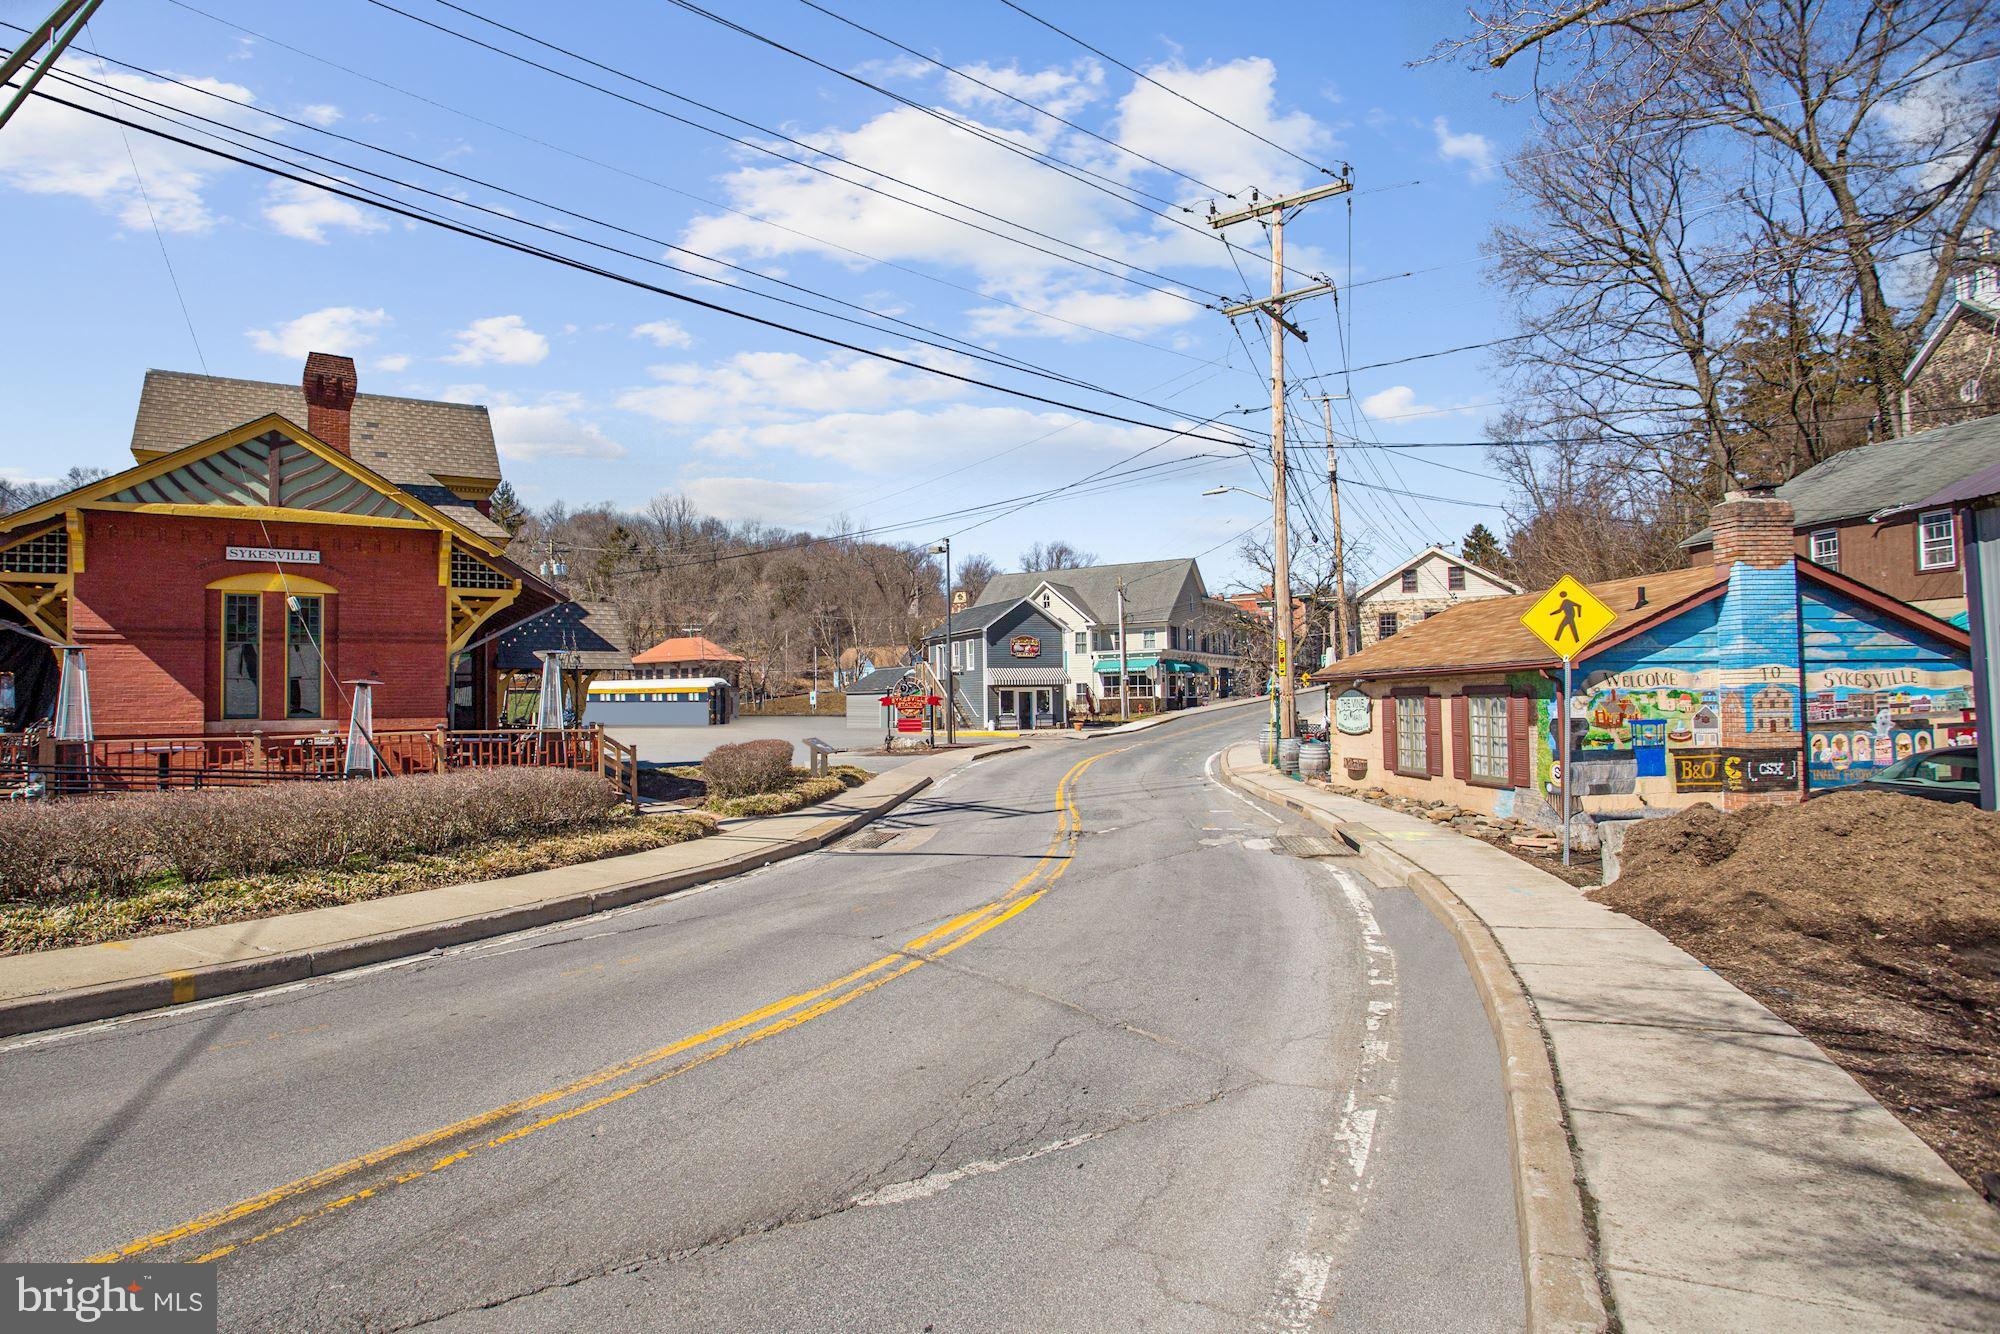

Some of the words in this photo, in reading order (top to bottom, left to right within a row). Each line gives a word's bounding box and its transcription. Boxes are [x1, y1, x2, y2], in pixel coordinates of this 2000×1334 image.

[229, 548, 317, 561] SYKESVILLE
[1603, 672, 1678, 688] WELCOME
[1759, 666, 1781, 681] TO
[1824, 670, 1918, 689] SYKESVILLE
[1681, 760, 1716, 779] B&O
